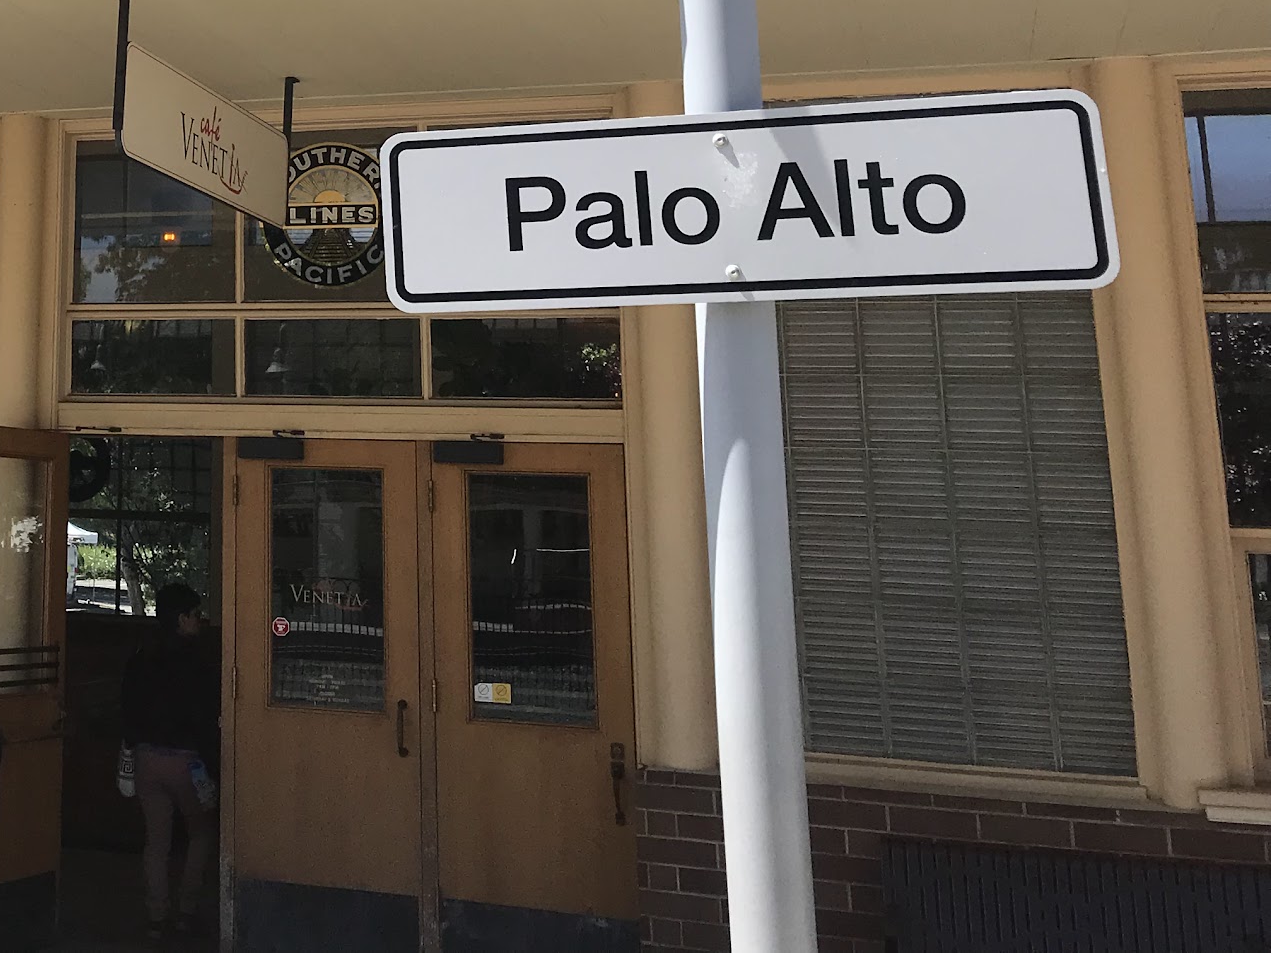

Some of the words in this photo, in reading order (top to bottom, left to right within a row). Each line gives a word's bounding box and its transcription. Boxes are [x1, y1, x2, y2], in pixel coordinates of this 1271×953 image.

[200, 106, 222, 148] café
[289, 206, 375, 224] LINES
[504, 170, 720, 252] Palo
[757, 158, 967, 241] Alto
[275, 242, 385, 285] PACIFIC
